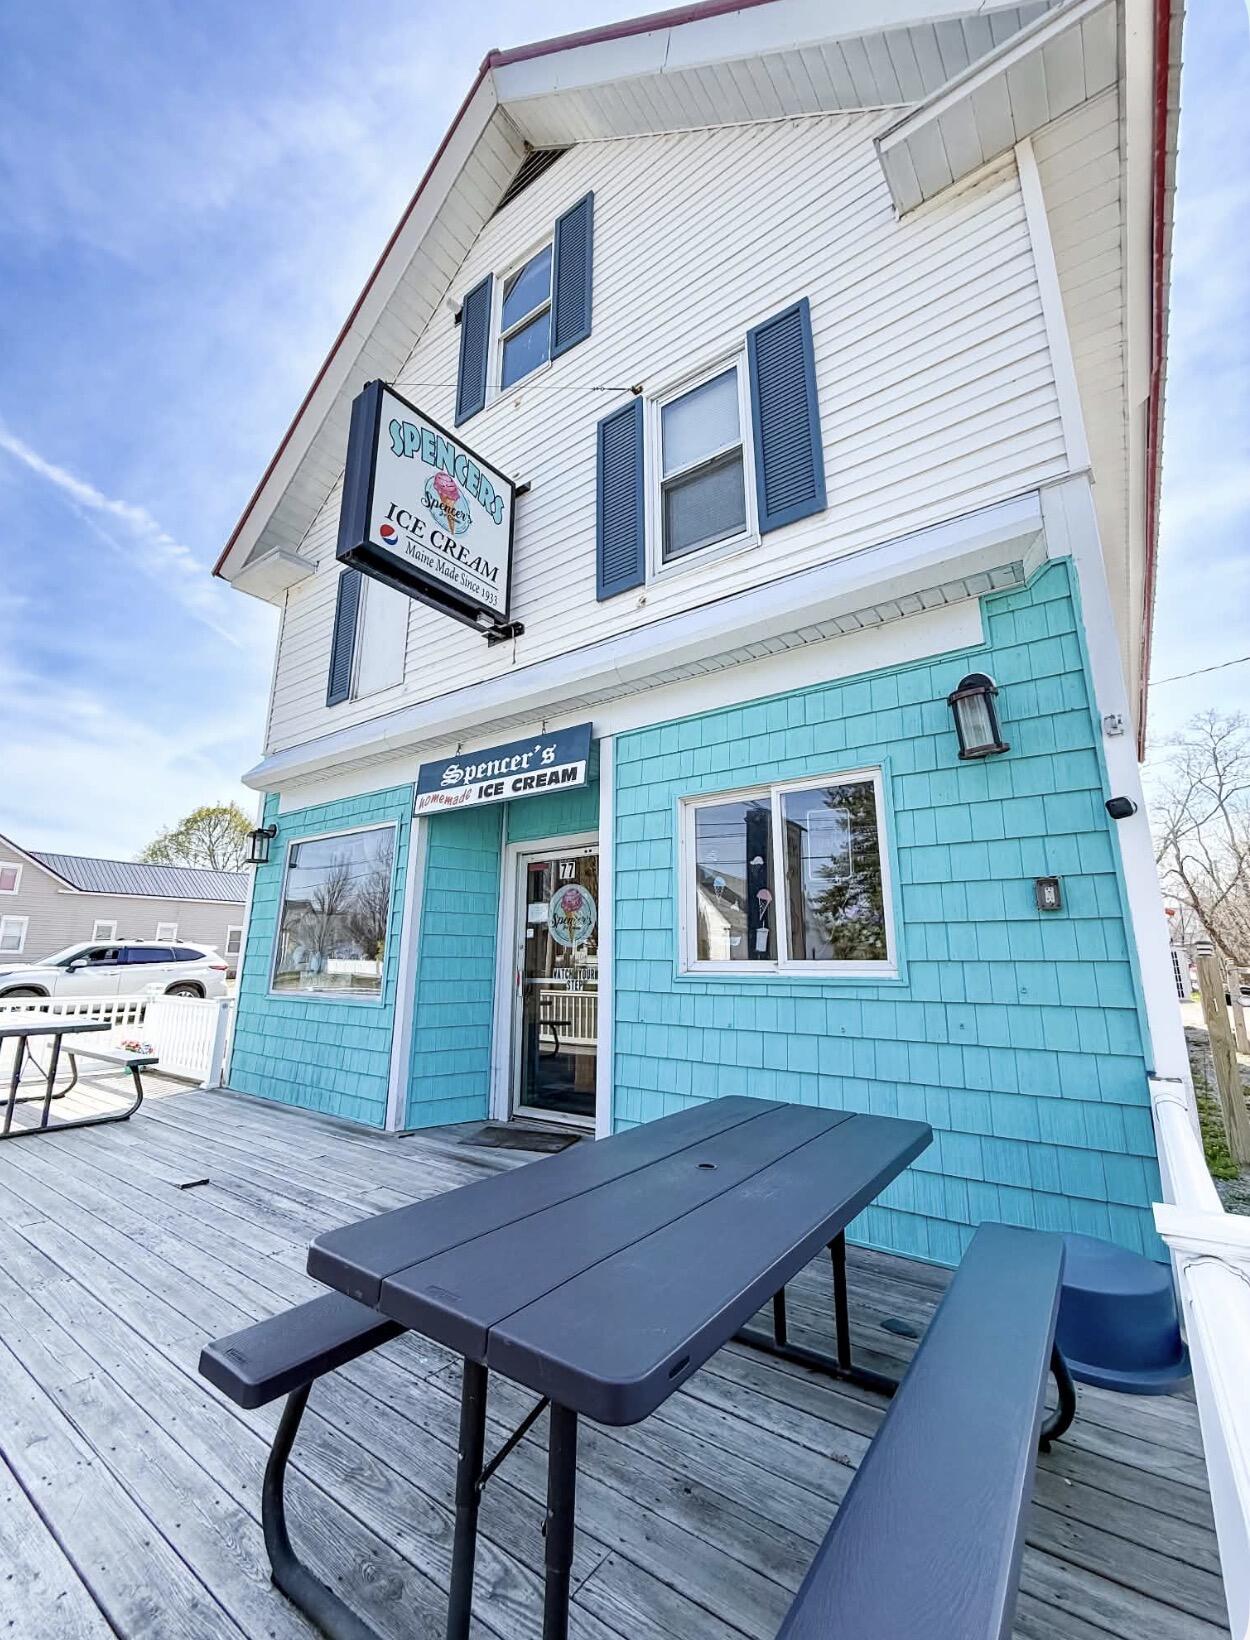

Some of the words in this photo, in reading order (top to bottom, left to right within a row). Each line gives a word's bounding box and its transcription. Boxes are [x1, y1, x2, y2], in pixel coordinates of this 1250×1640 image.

[389, 418, 505, 525] SPENCERS
[384, 502, 427, 539] ICE
[430, 530, 500, 583] CREAM
[405, 541, 434, 567] Maine
[435, 559, 459, 583] Made
[461, 573, 480, 594] Since
[482, 588, 498, 607] 1933
[440, 743, 557, 785] Spencer's
[418, 787, 472, 810] homemade
[477, 781, 504, 799] ICE
[511, 766, 578, 793] CREAM
[560, 862, 575, 878] 77
[567, 980, 584, 991] STEP
